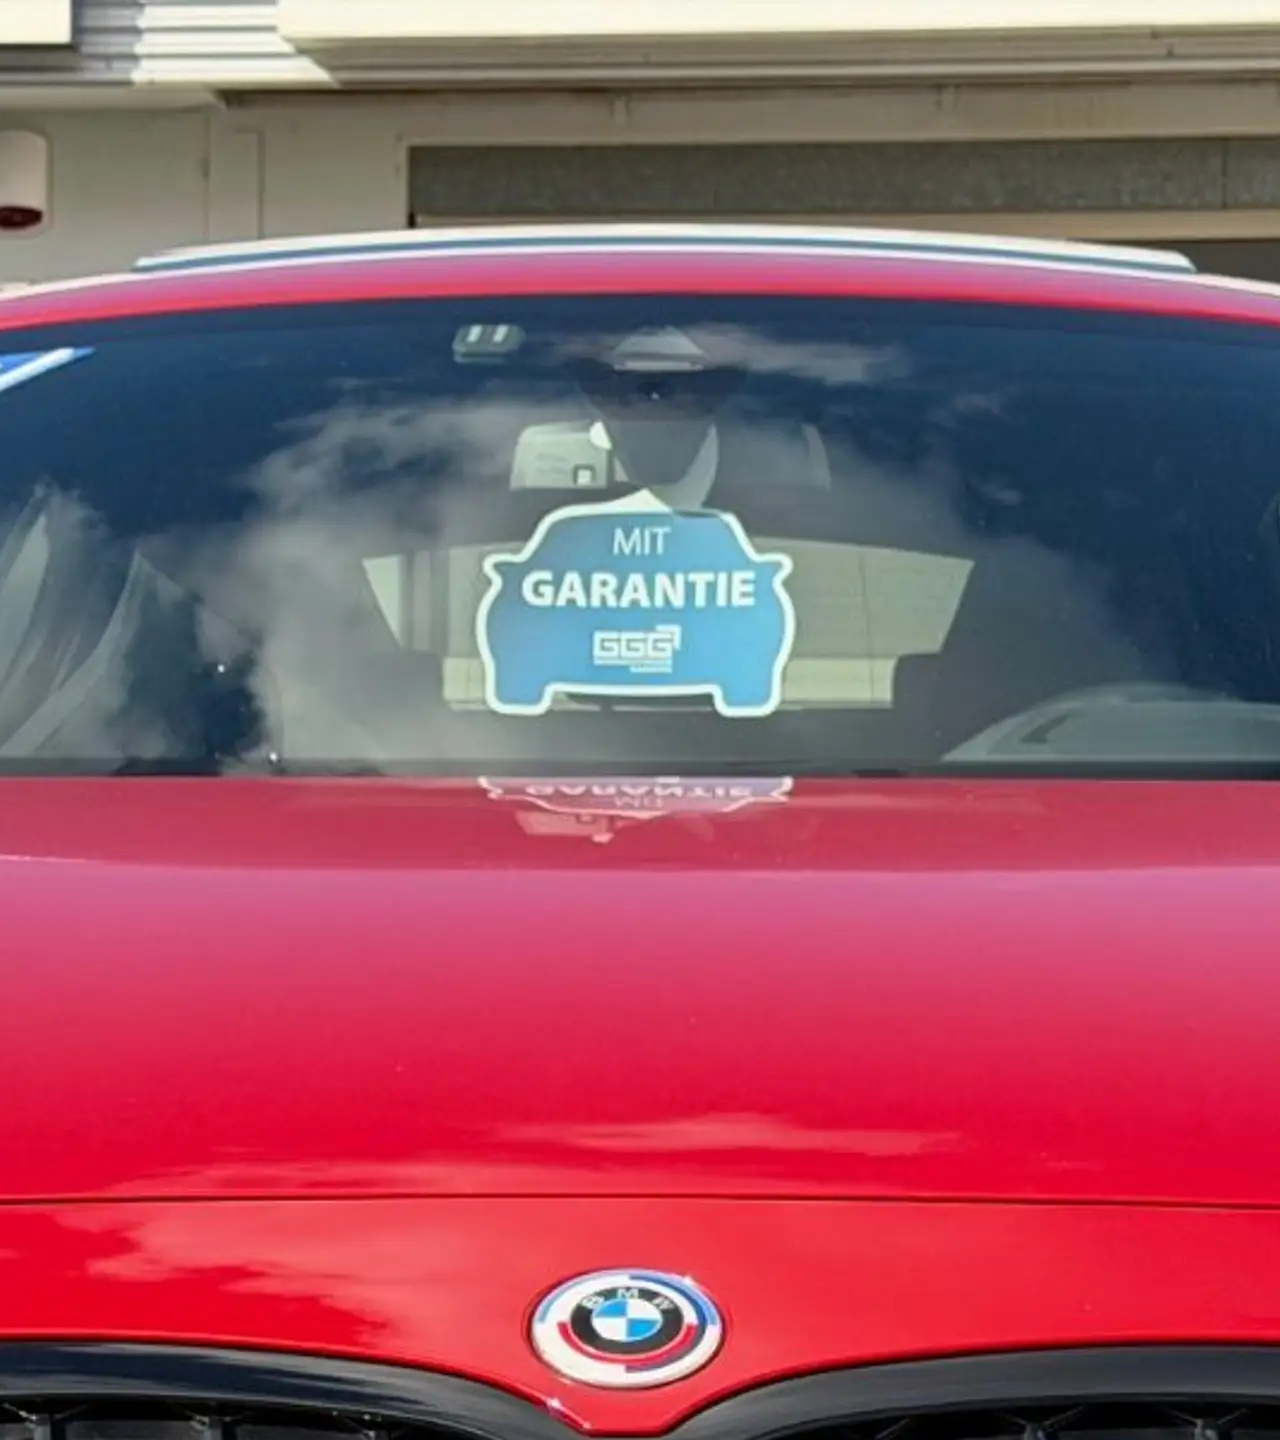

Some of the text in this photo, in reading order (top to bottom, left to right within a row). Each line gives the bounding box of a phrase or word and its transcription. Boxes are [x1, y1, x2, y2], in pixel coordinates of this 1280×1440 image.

[613, 527, 672, 556] MIT
[521, 570, 757, 609] GARANTIE
[581, 1288, 675, 1310] BMW
